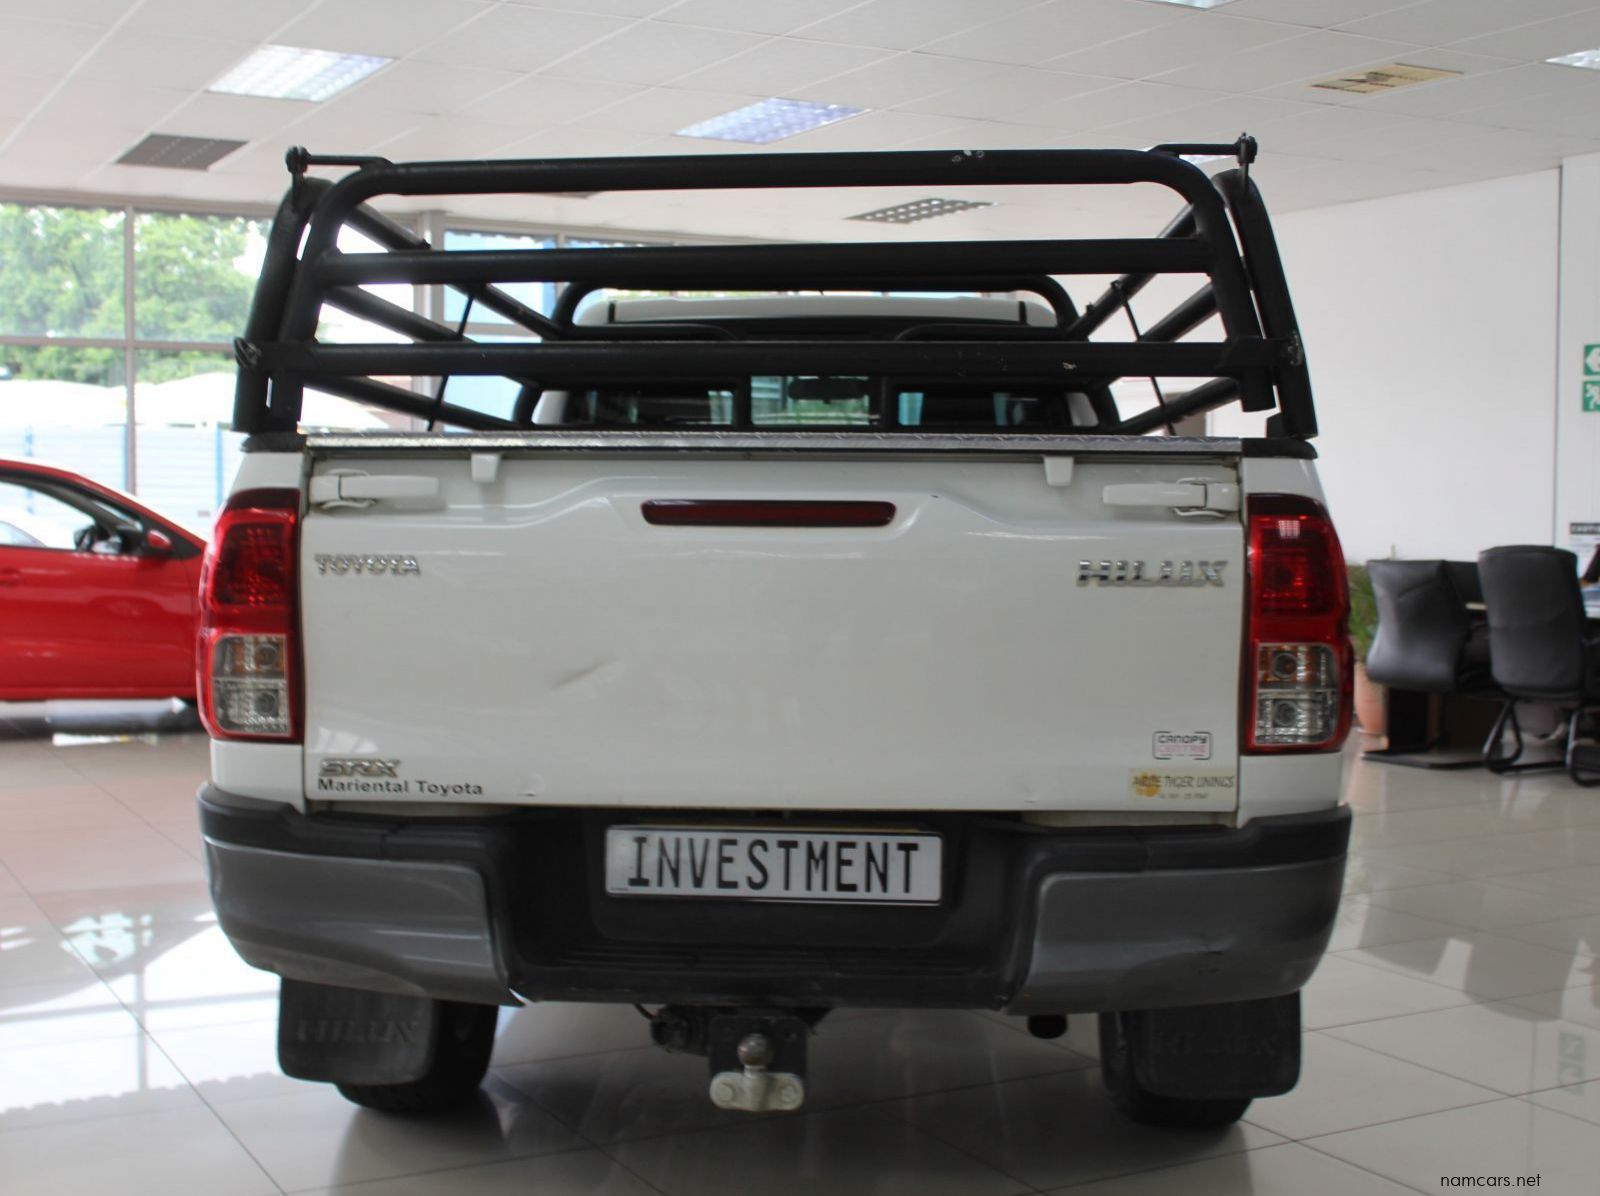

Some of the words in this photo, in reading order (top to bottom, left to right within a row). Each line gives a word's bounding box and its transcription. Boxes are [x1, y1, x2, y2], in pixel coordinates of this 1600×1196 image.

[314, 553, 421, 576] TOYOTA
[1077, 560, 1228, 587] HILUX
[319, 758, 401, 778] SRX
[318, 778, 409, 793] Mariental
[416, 780, 483, 797] Toyota
[628, 836, 919, 893] INVESTMENT
